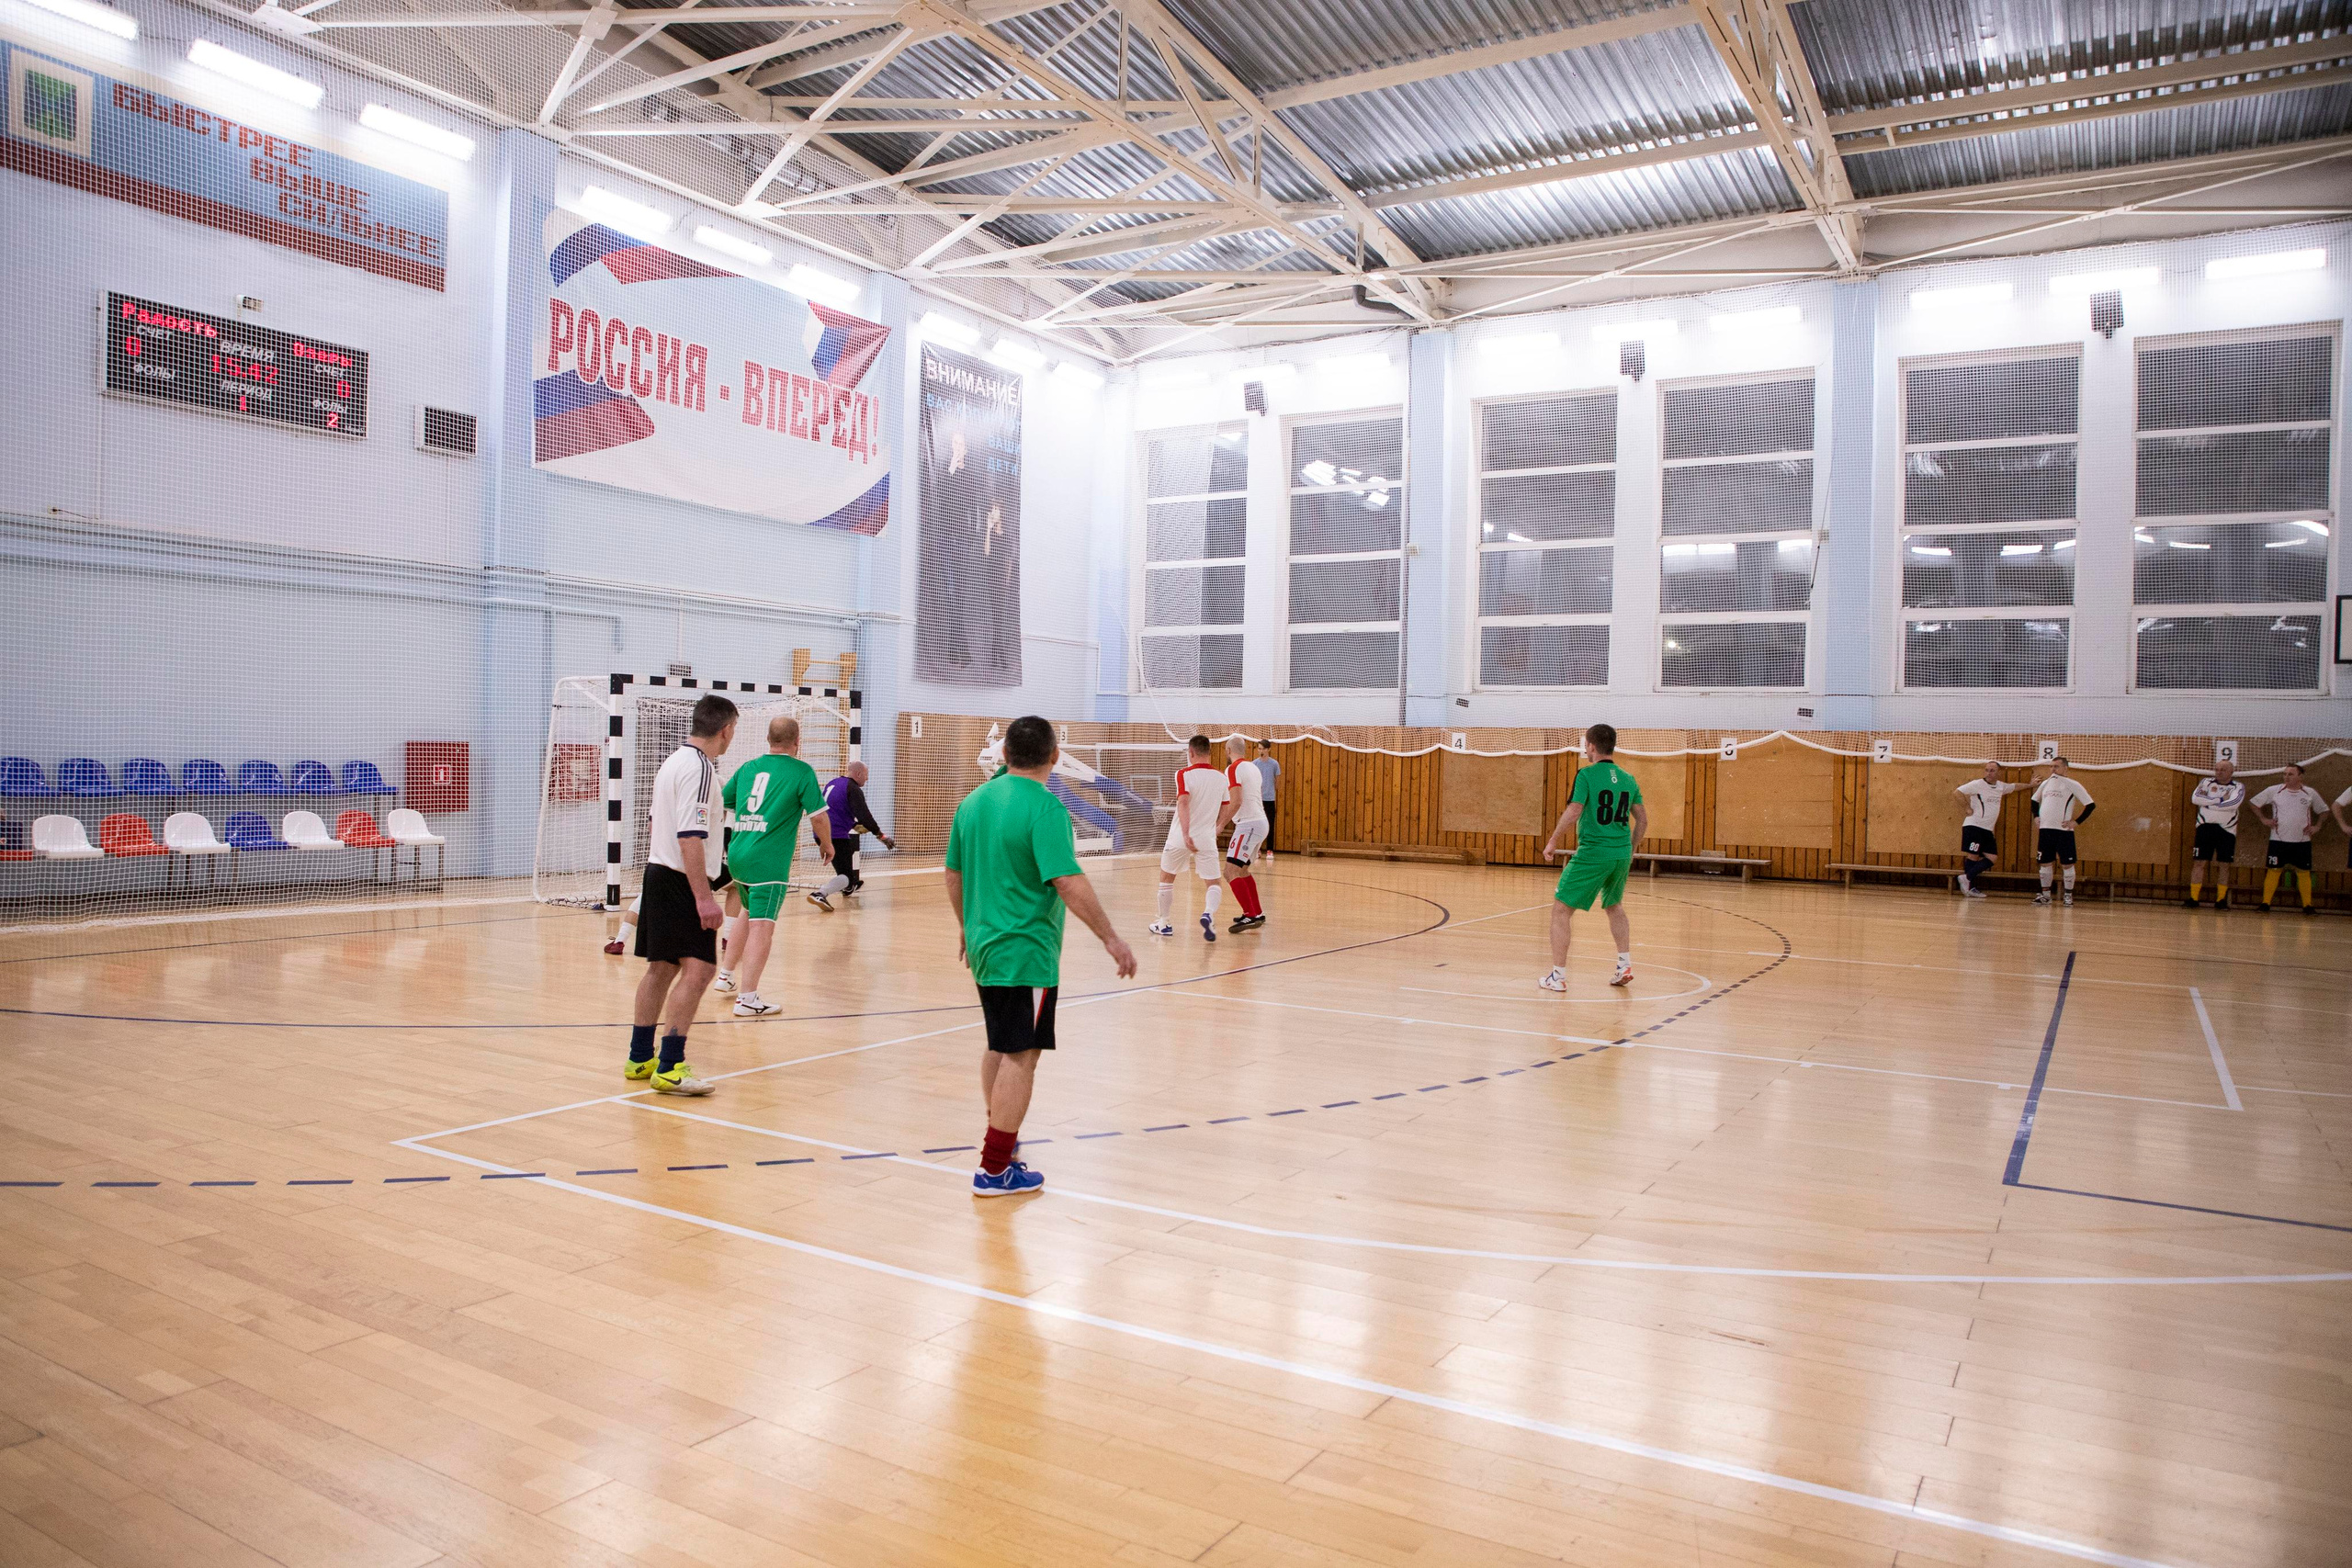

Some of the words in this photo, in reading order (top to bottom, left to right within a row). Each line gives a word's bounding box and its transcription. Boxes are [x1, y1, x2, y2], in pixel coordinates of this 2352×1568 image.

[113, 82, 313, 170] БЫСТРЕЕ
[249, 157, 370, 213] ВЫШЕ
[277, 191, 440, 261] СИЛЬНЕЕ
[137, 324, 173, 340] СЧЕТ
[126, 335, 141, 356] 0
[220, 340, 276, 363] ВРЕМЯ
[133, 364, 176, 380] ФОЛЫ
[315, 364, 347, 378] СЧЕТ
[337, 379, 351, 399] 0
[548, 297, 708, 412] РОССИЯ
[742, 359, 879, 465] ВПЕРЕД!
[220, 380, 273, 402] ПЕРИОД
[312, 399, 349, 414] ФОЛЫ
[327, 412, 339, 429] 2
[914, 720, 919, 734] 1
[1061, 731, 1066, 740] 3
[1454, 738, 1464, 750] 4
[1878, 745, 1888, 759] 7
[2043, 747, 2053, 760] 8
[2222, 747, 2233, 761] 9
[746, 772, 771, 813] 9
[1596, 789, 1630, 827] 84
[1968, 841, 1980, 852] 80
